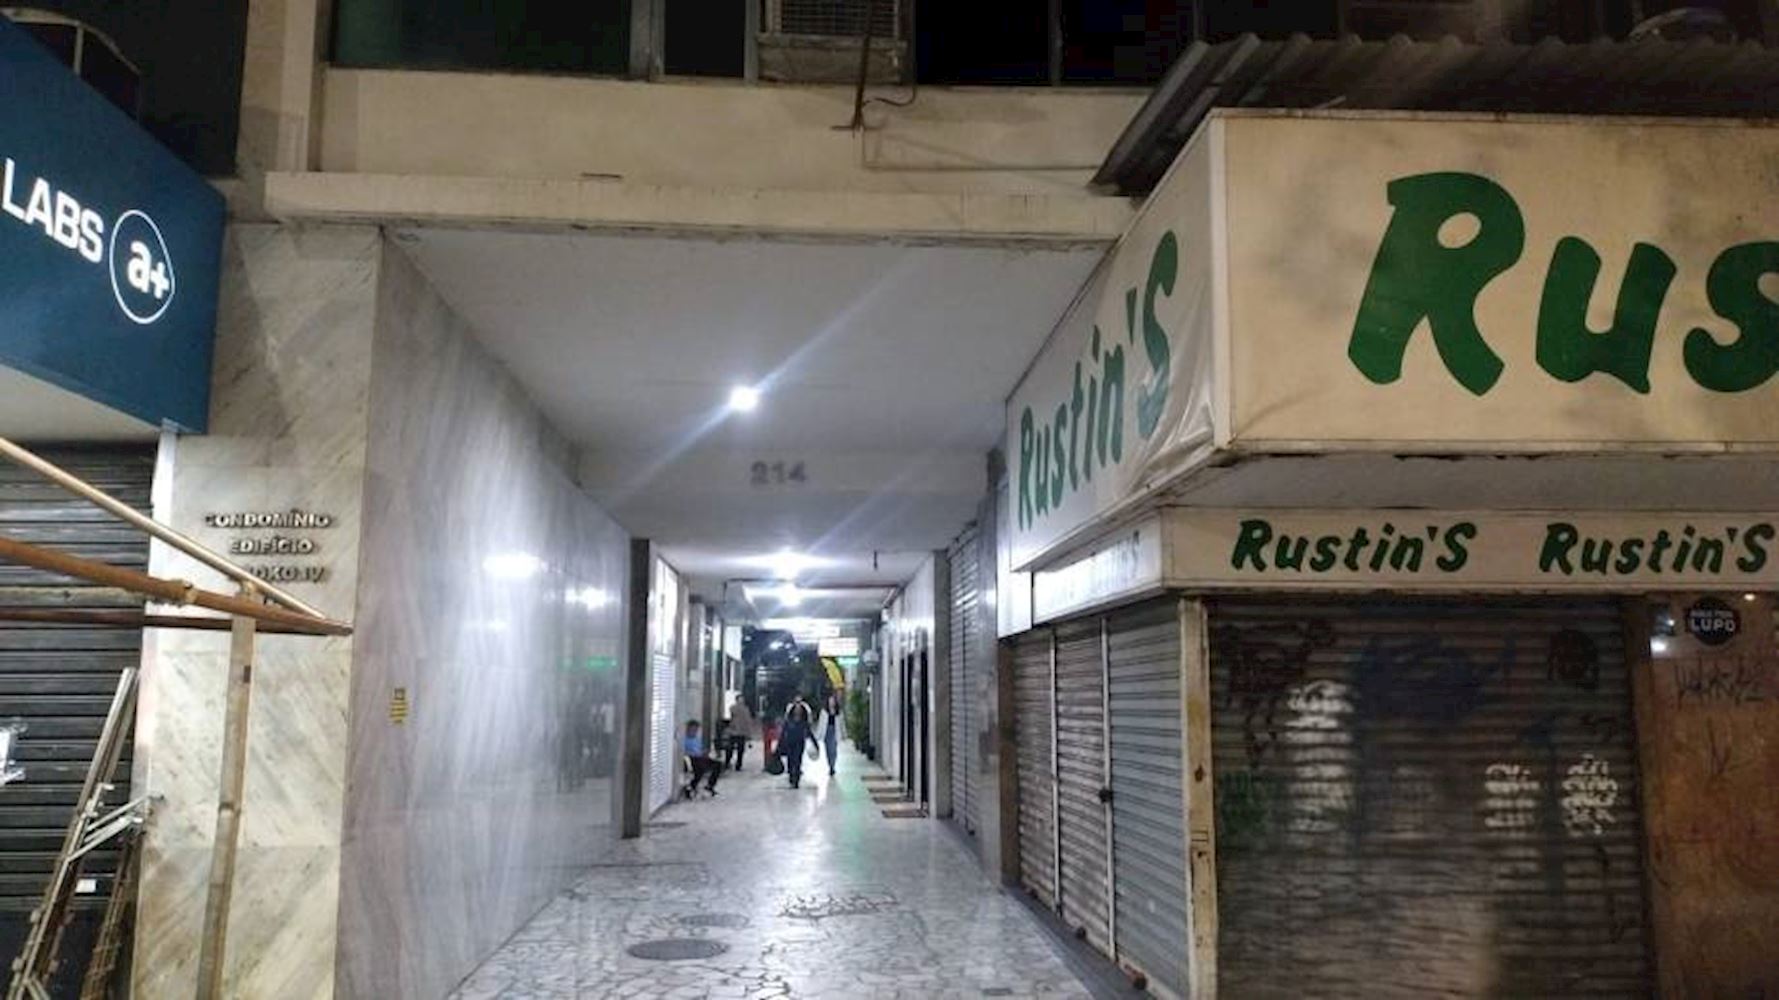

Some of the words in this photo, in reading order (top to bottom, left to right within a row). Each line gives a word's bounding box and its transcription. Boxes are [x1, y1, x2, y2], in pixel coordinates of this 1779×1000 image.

[2, 157, 104, 264] LABS
[1017, 229, 1179, 532] Rustin'S
[751, 459, 807, 485] 214
[205, 508, 333, 528] CONDOMÍNIO
[230, 535, 314, 555] EDIFÍCIO
[1231, 518, 1477, 573] Rustin'S
[1538, 521, 1776, 576] Rustin'S
[1690, 617, 1736, 633] LUPO
